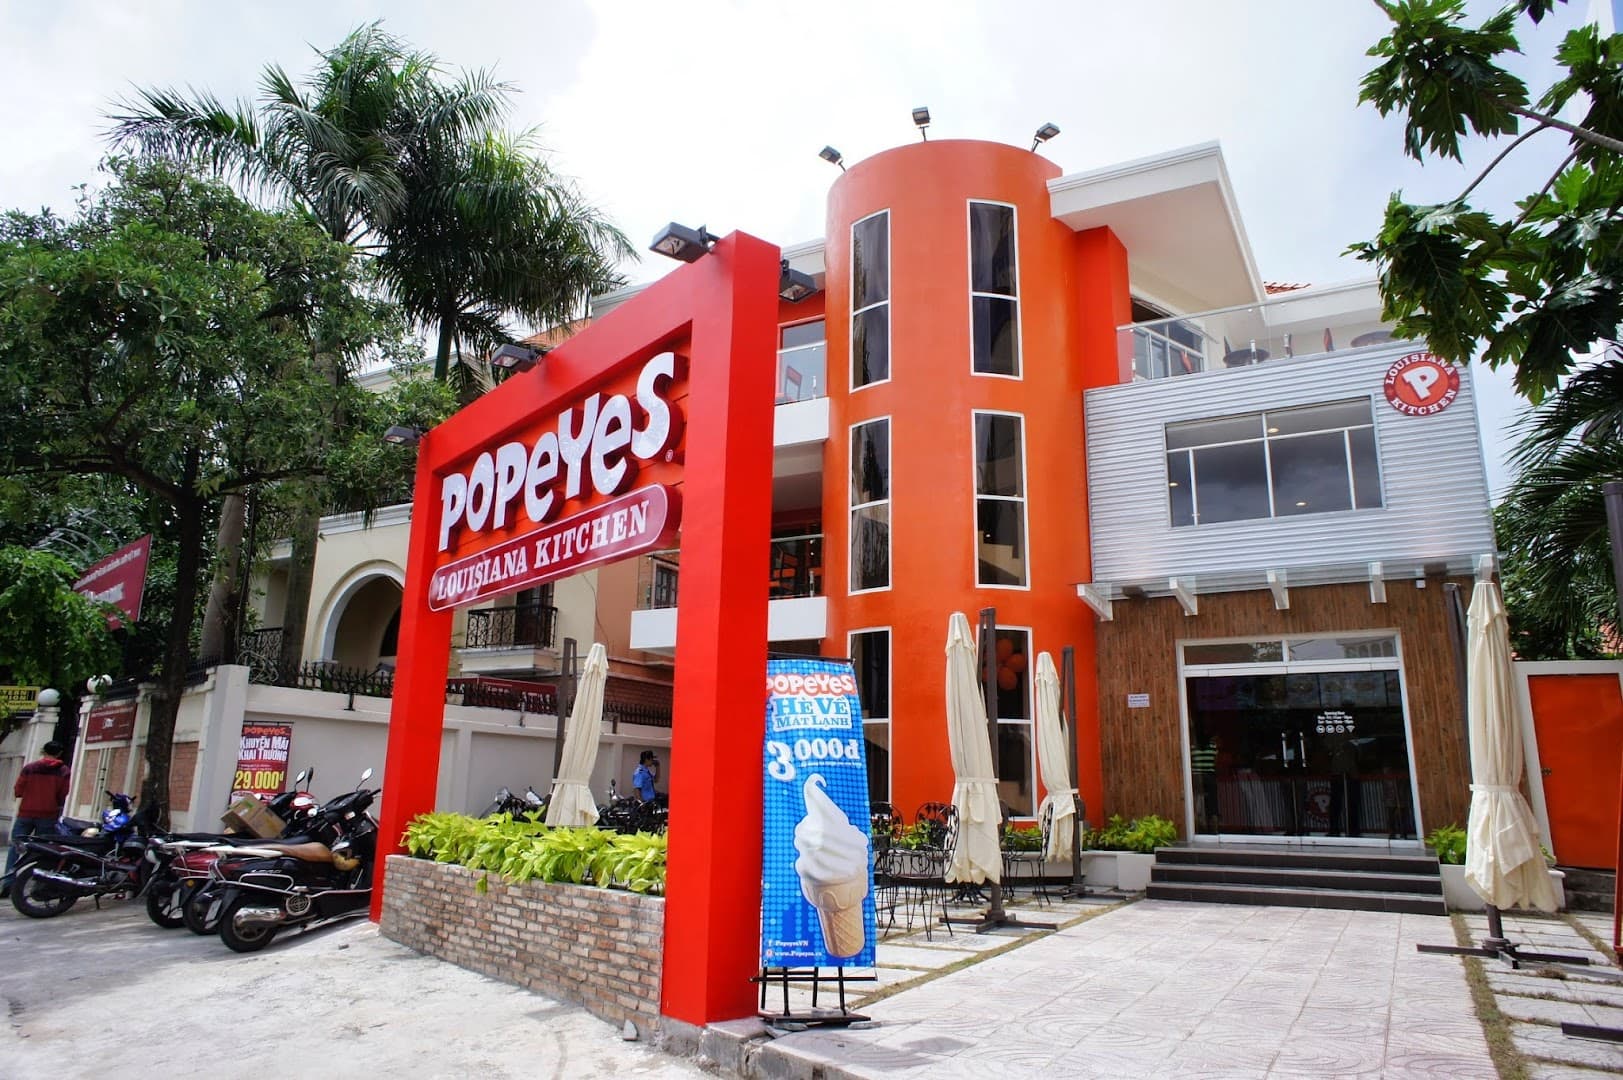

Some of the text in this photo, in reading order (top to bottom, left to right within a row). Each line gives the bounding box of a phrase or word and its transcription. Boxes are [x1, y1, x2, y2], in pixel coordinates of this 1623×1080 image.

[1385, 353, 1455, 385] LOUISIANA
[1402, 365, 1440, 400] P
[1390, 389, 1457, 415] KITCHEN
[437, 500, 650, 601] LOUISIANA KITCHEN
